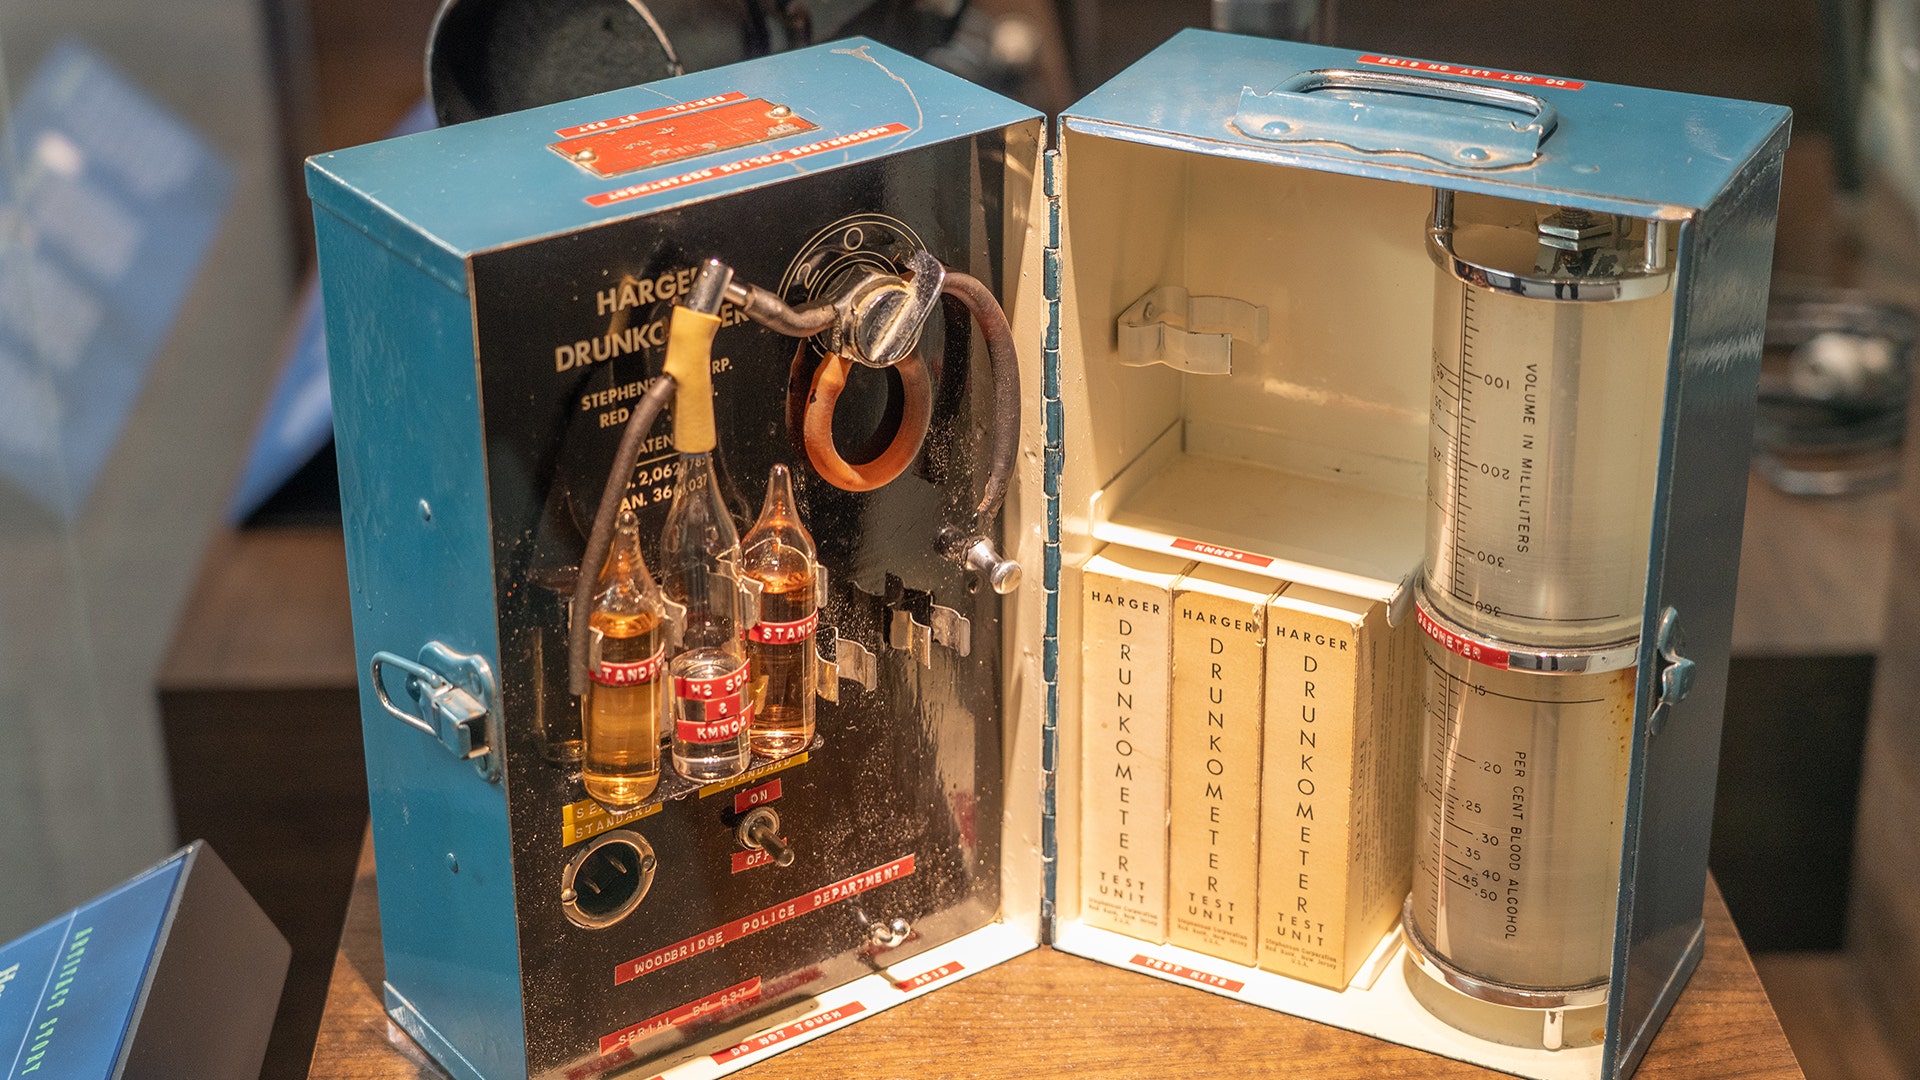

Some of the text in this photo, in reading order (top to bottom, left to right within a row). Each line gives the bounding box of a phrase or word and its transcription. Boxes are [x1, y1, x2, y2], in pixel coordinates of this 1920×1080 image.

[1378, 57, 1567, 86] DO NOT LAY ON SIDE
[789, 127, 890, 156] WOODBRIDGE
[719, 153, 783, 173] POLICE
[608, 169, 713, 200] DEPARTMENT
[596, 266, 699, 316] HARGE
[555, 303, 750, 373] DRUNKOER
[1484, 373, 1510, 390] 100
[581, 376, 657, 411] STEPHENS
[600, 407, 629, 429] RED
[1516, 363, 1538, 554] VOLUME IN MILLILITERS
[1481, 464, 1510, 480] 200
[620, 492, 648, 512] AN.
[1477, 551, 1505, 568] 300
[1091, 591, 1160, 615] HARGER
[1183, 608, 1253, 633] HARGER
[1276, 626, 1348, 651] HARGER
[1417, 612, 1481, 660] GASOMETER
[691, 683, 712, 697] H2
[1470, 684, 1486, 696] .15
[1115, 619, 1133, 871] DRUNKOMETER
[1205, 638, 1224, 892] DRUNKOMETER
[1479, 761, 1502, 775] .20
[1296, 656, 1318, 913] DRUNKOMETER
[750, 789, 768, 804] ON
[1461, 800, 1482, 813] .25
[1476, 833, 1499, 846] .30
[1505, 751, 1526, 939] PER CENT BLOOD ALCOHOL
[1461, 847, 1481, 860] .35
[1100, 871, 1145, 891] TEST
[1458, 875, 1479, 887] .45
[1475, 869, 1501, 882] .40
[1100, 885, 1144, 904] UNIT
[1189, 892, 1234, 911] TEST
[1475, 889, 1498, 902] .50
[634, 864, 901, 976] WOODBRIDGE POLICE DEPARTMENT
[1189, 905, 1234, 925] UNIT
[1278, 911, 1324, 933] TEST
[1277, 926, 1323, 947] UNIT
[914, 966, 950, 986] ACID
[1145, 957, 1228, 987] TEST KITS
[21, 926, 94, 1076] ARTIFACT STORY
[618, 987, 747, 1046] SERIAL BT 837
[730, 1010, 842, 1057] DO NOT TOUCH
